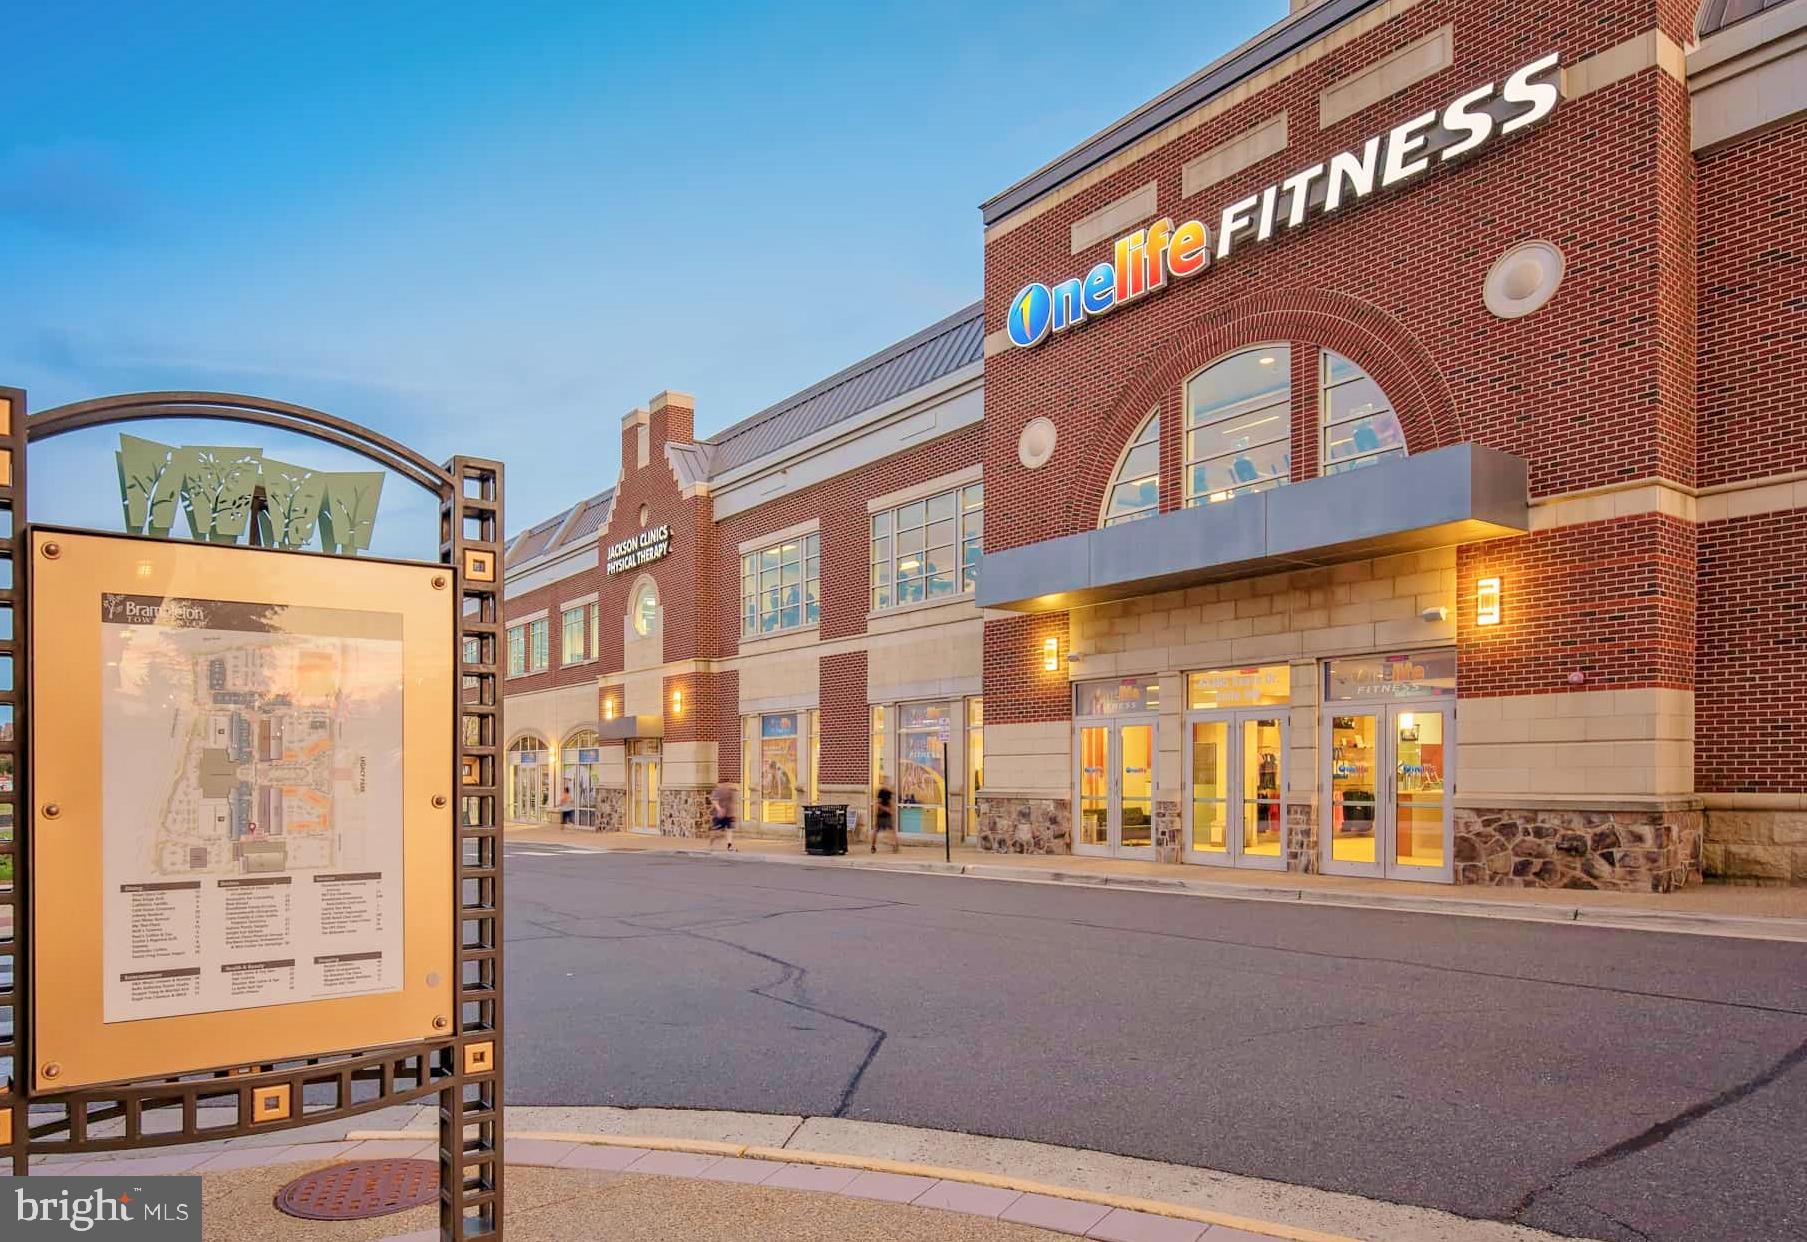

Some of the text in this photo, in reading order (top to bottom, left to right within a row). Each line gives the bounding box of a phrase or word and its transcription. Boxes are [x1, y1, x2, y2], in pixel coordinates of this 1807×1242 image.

[1007, 52, 1560, 347] Onelife FITNESS
[607, 541, 668, 576] PHYSICAL THERAPY
[608, 525, 669, 560] JACKSON CLINICS
[1357, 683, 1420, 695] FITNESS
